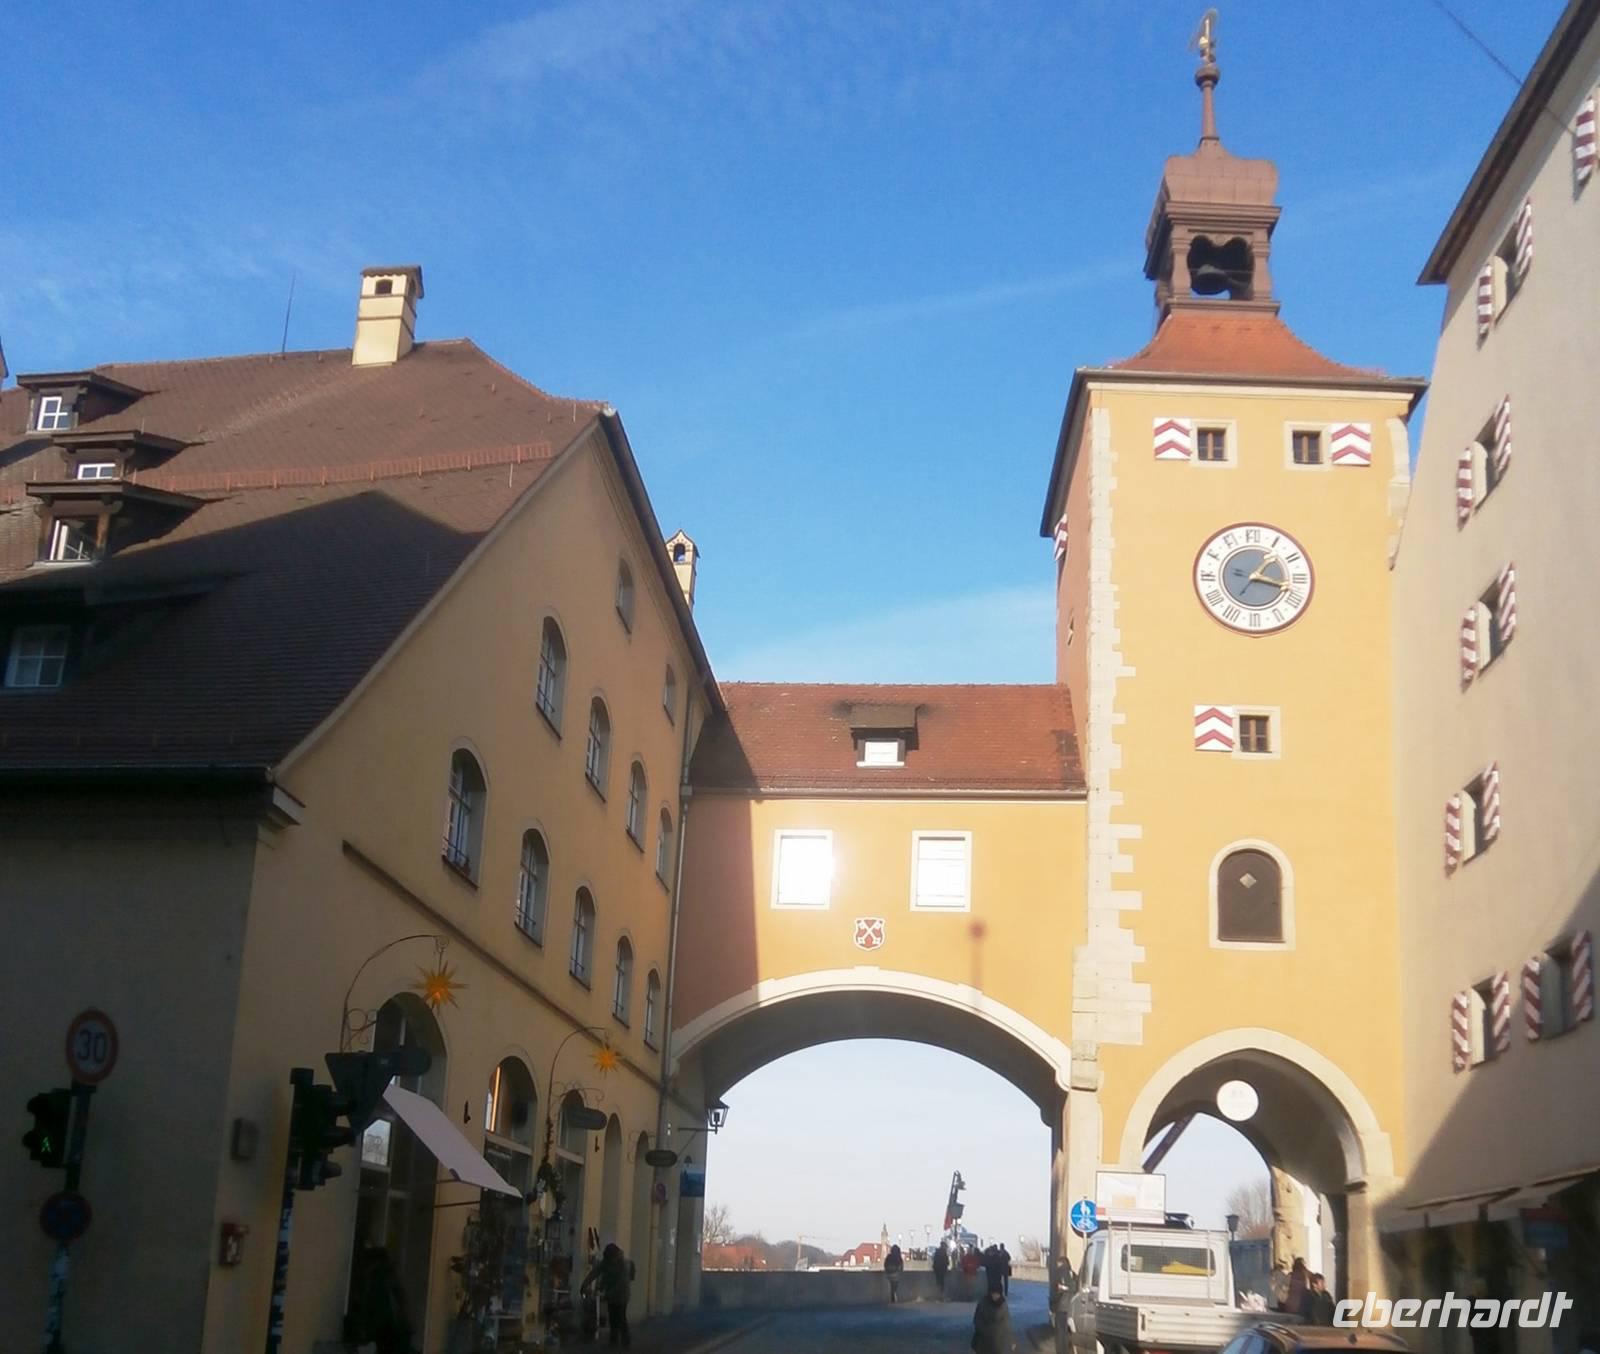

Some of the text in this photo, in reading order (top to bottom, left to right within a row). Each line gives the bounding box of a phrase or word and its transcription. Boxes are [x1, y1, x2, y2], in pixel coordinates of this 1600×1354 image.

[1271, 535, 1280, 548] I
[1285, 551, 1301, 563] II
[1292, 573, 1308, 584] III
[77, 1028, 107, 1064] 30
